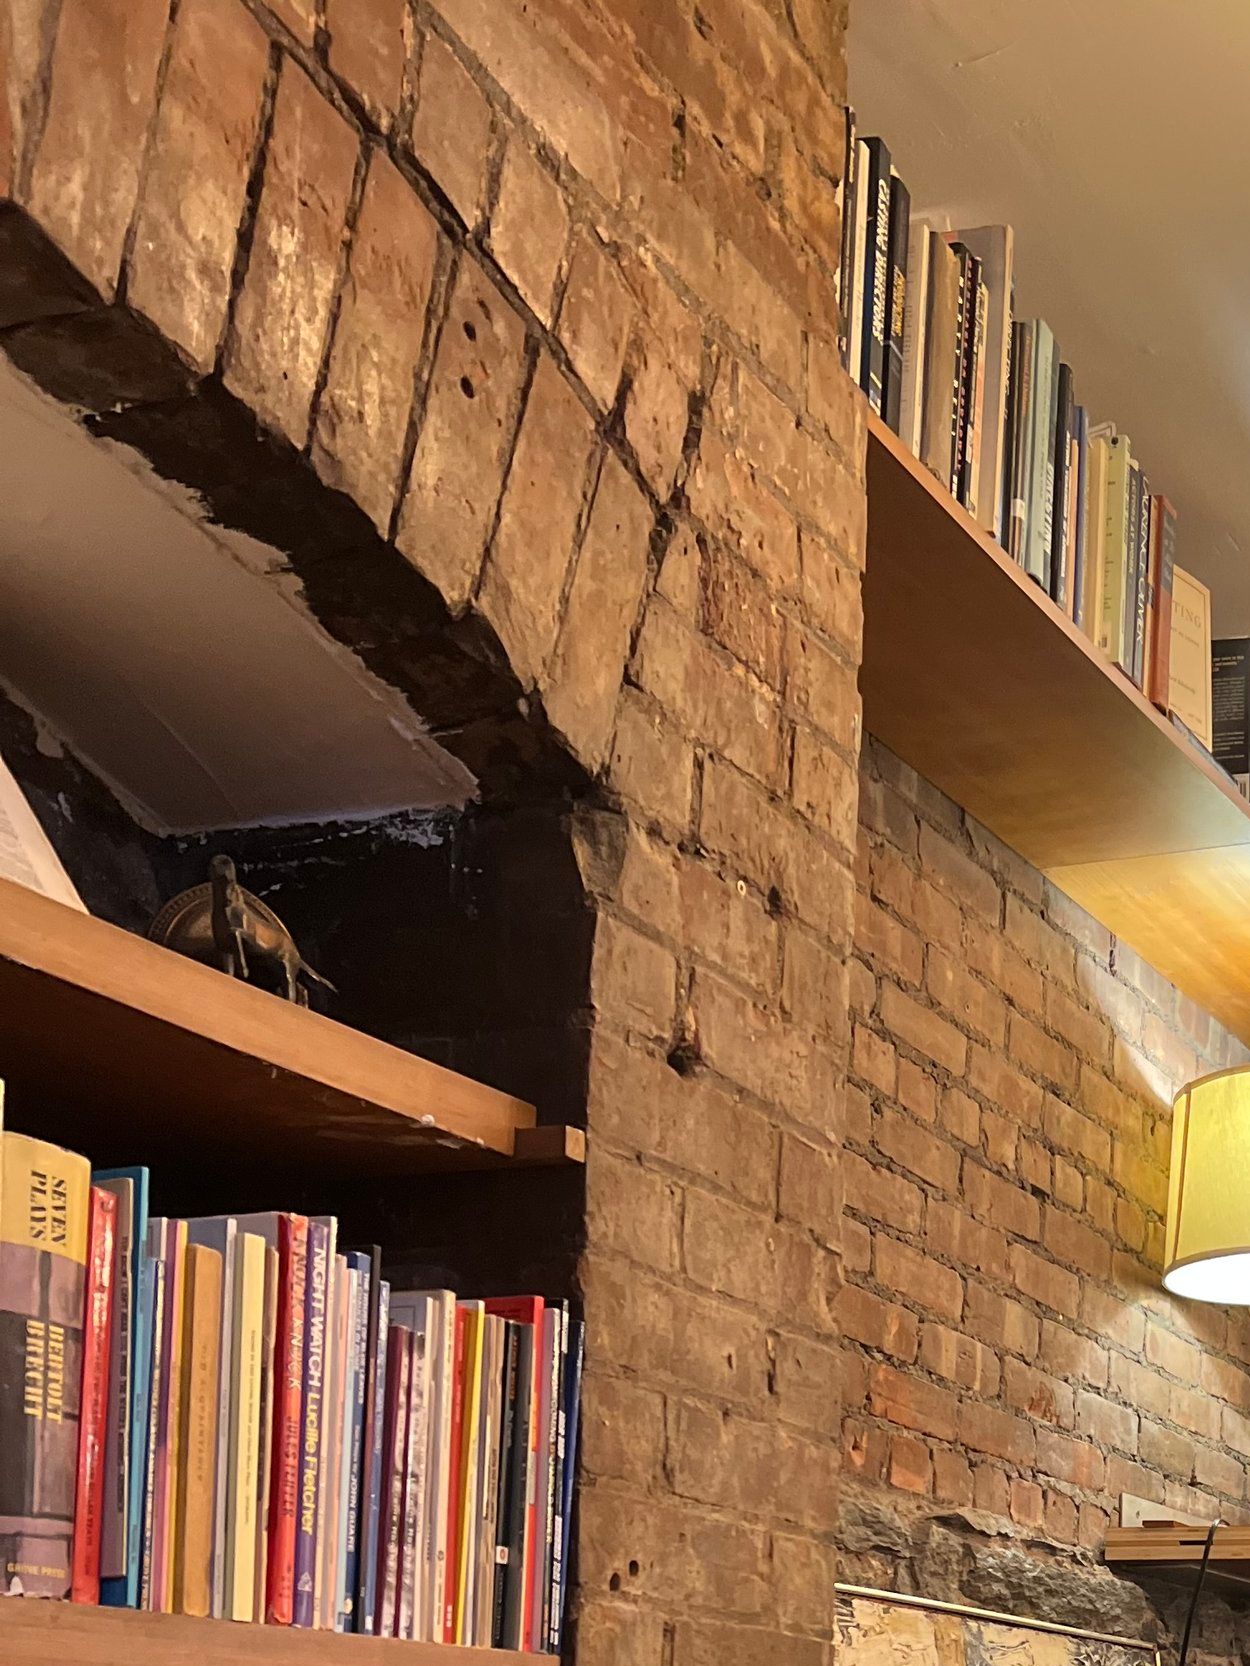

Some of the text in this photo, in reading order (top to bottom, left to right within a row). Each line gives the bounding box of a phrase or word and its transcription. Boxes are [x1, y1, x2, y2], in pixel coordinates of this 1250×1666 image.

[1172, 600, 1202, 629] TING
[30, 1169, 47, 1241] PLAYS
[51, 1176, 67, 1246] SEVEN
[307, 1248, 327, 1387] NIGHT WATCH
[23, 1318, 45, 1421] BRECHT
[46, 1324, 65, 1425] BERTOLT
[301, 1392, 320, 1535] Lucille Fletcher
[349, 1474, 358, 1508] JOHN
